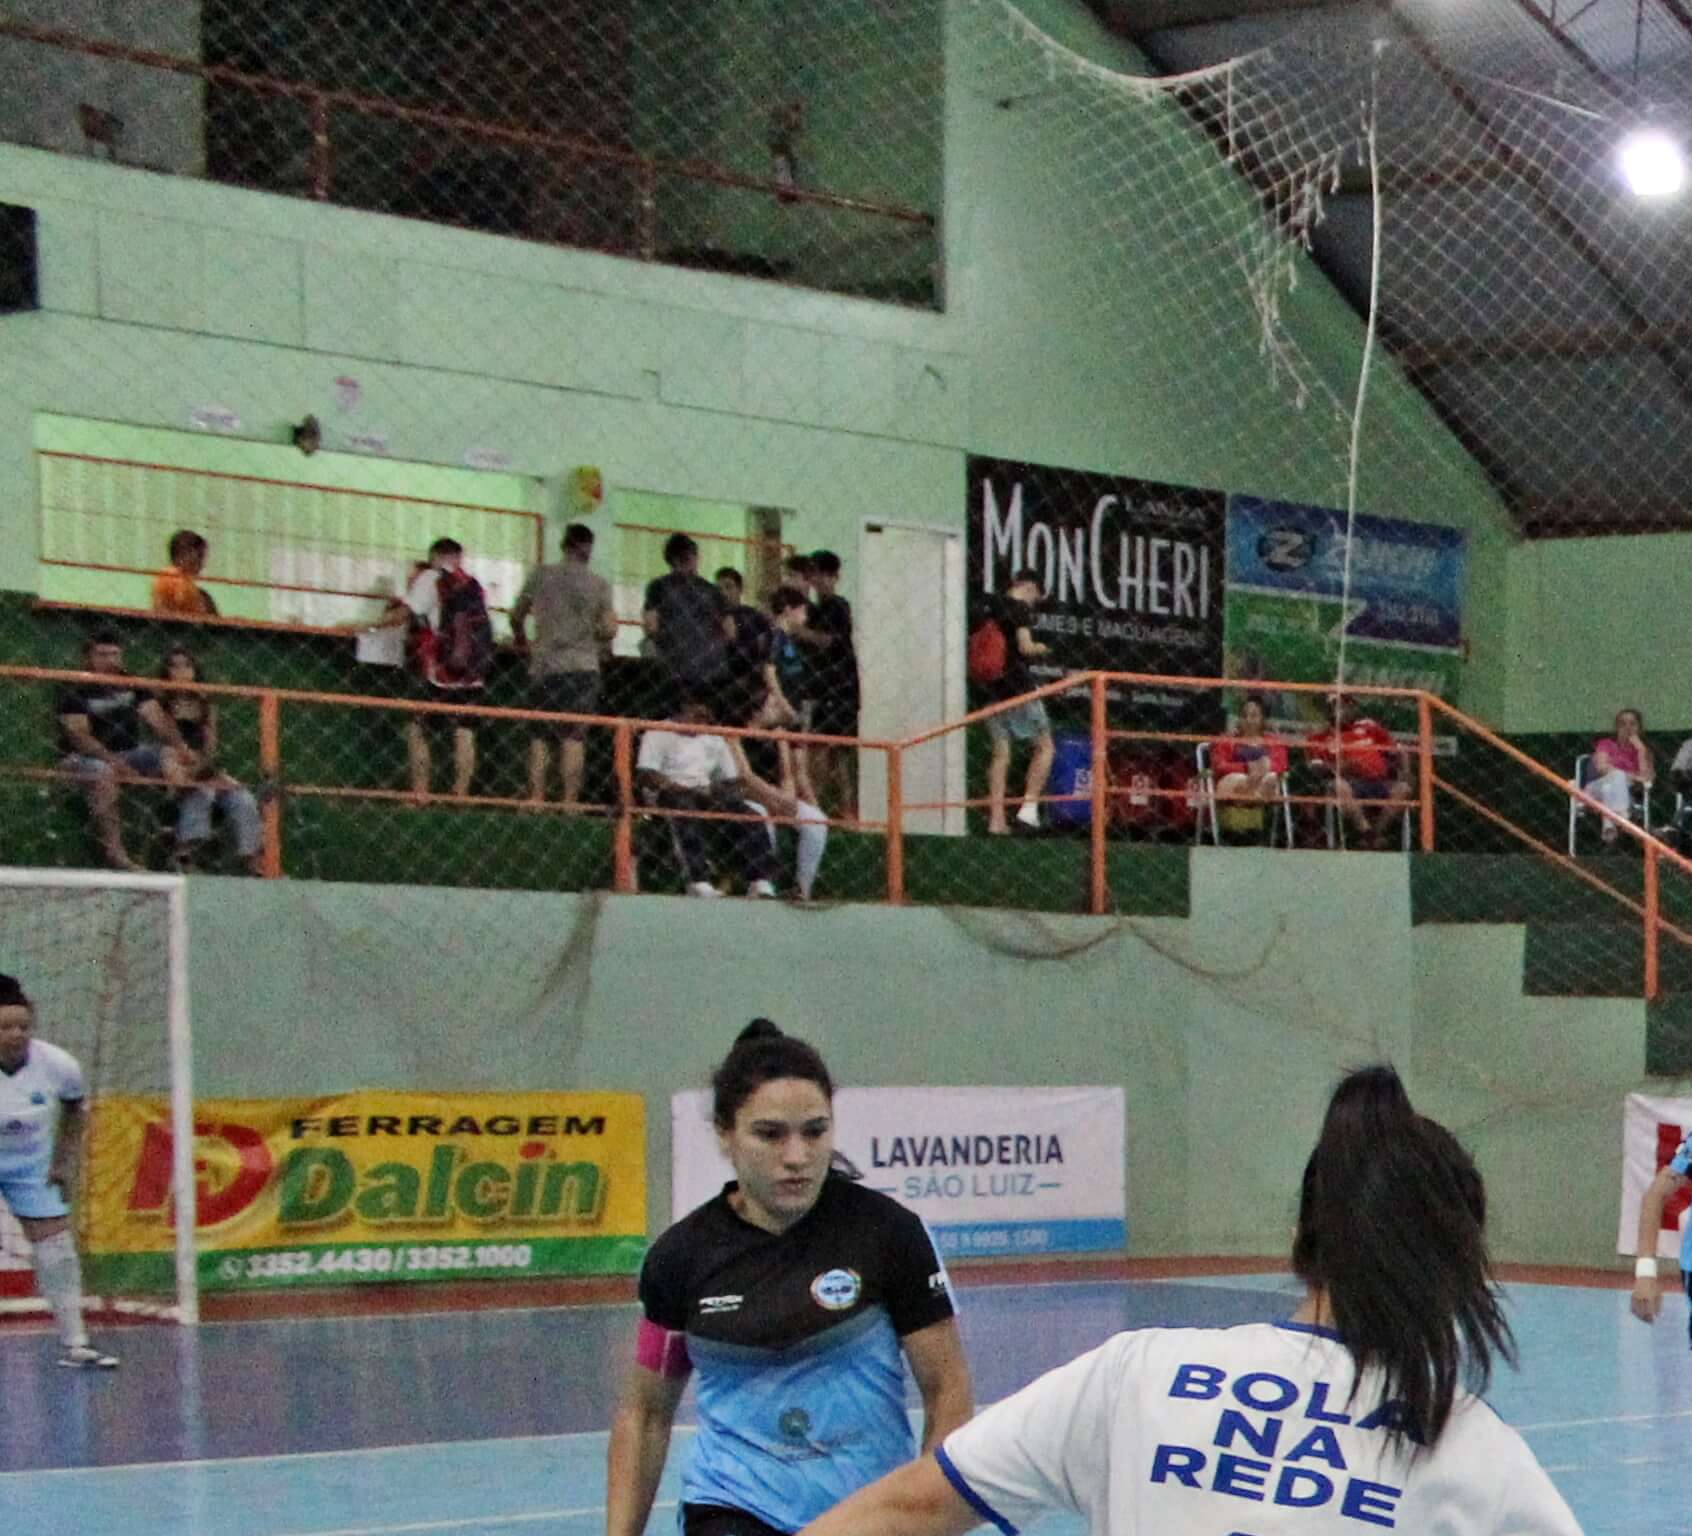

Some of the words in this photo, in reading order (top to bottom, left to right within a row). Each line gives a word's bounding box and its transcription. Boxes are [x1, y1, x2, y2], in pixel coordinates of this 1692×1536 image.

[288, 1114, 607, 1139] FERRAGEM
[871, 1134, 1065, 1170] LAVANDERIA
[276, 1140, 605, 1230] Dalcin
[903, 1172, 964, 1200] SÃO
[972, 1173, 1036, 1196] LUIZ
[1167, 1363, 1427, 1446] BOLA
[1212, 1408, 1348, 1471] NA
[1149, 1443, 1403, 1529] REDE
